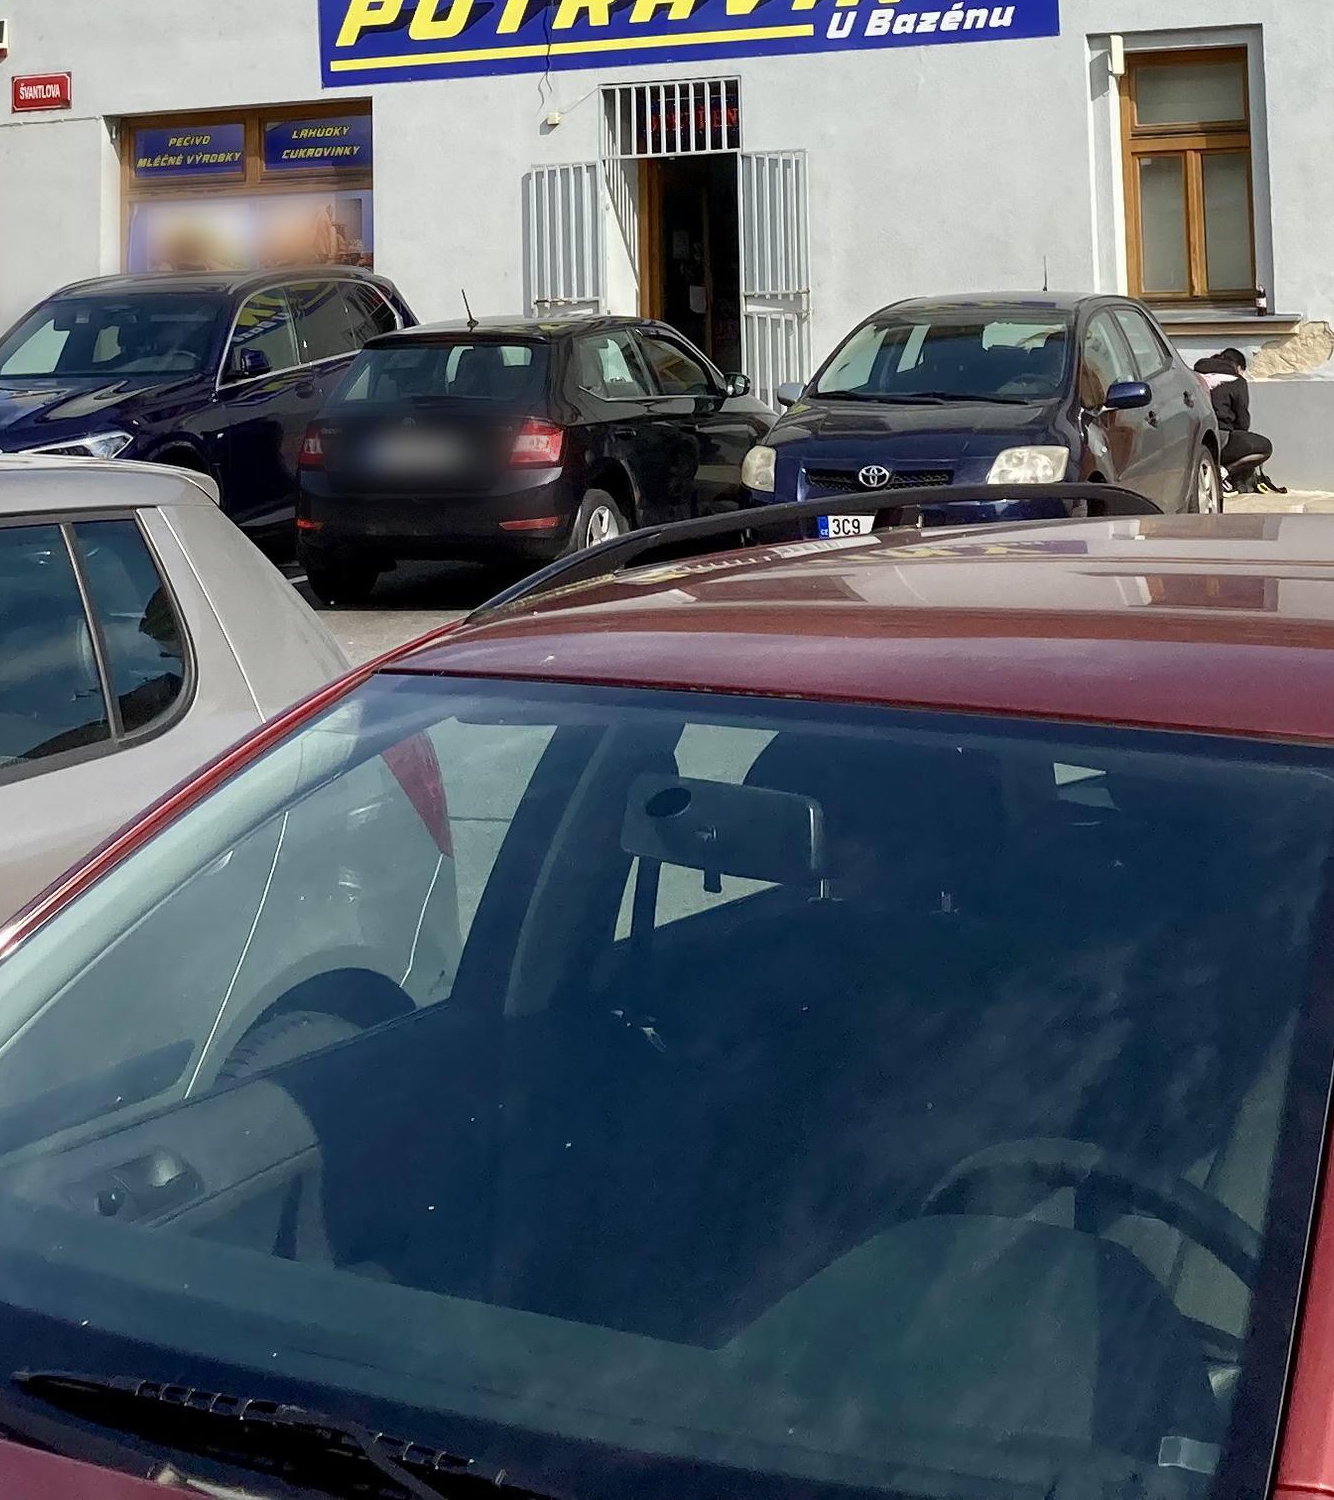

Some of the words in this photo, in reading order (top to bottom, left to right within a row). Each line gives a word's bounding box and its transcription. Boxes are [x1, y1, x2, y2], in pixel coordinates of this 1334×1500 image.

[826, 10, 857, 39] U
[864, 2, 1016, 37] Bazénu
[19, 83, 61, 100] ŠVANTLOVA
[168, 134, 211, 148] PEČIVO
[186, 152, 242, 165] VÝROBKY
[281, 146, 360, 160] CUKROVINKY
[832, 518, 861, 535] 3C9
